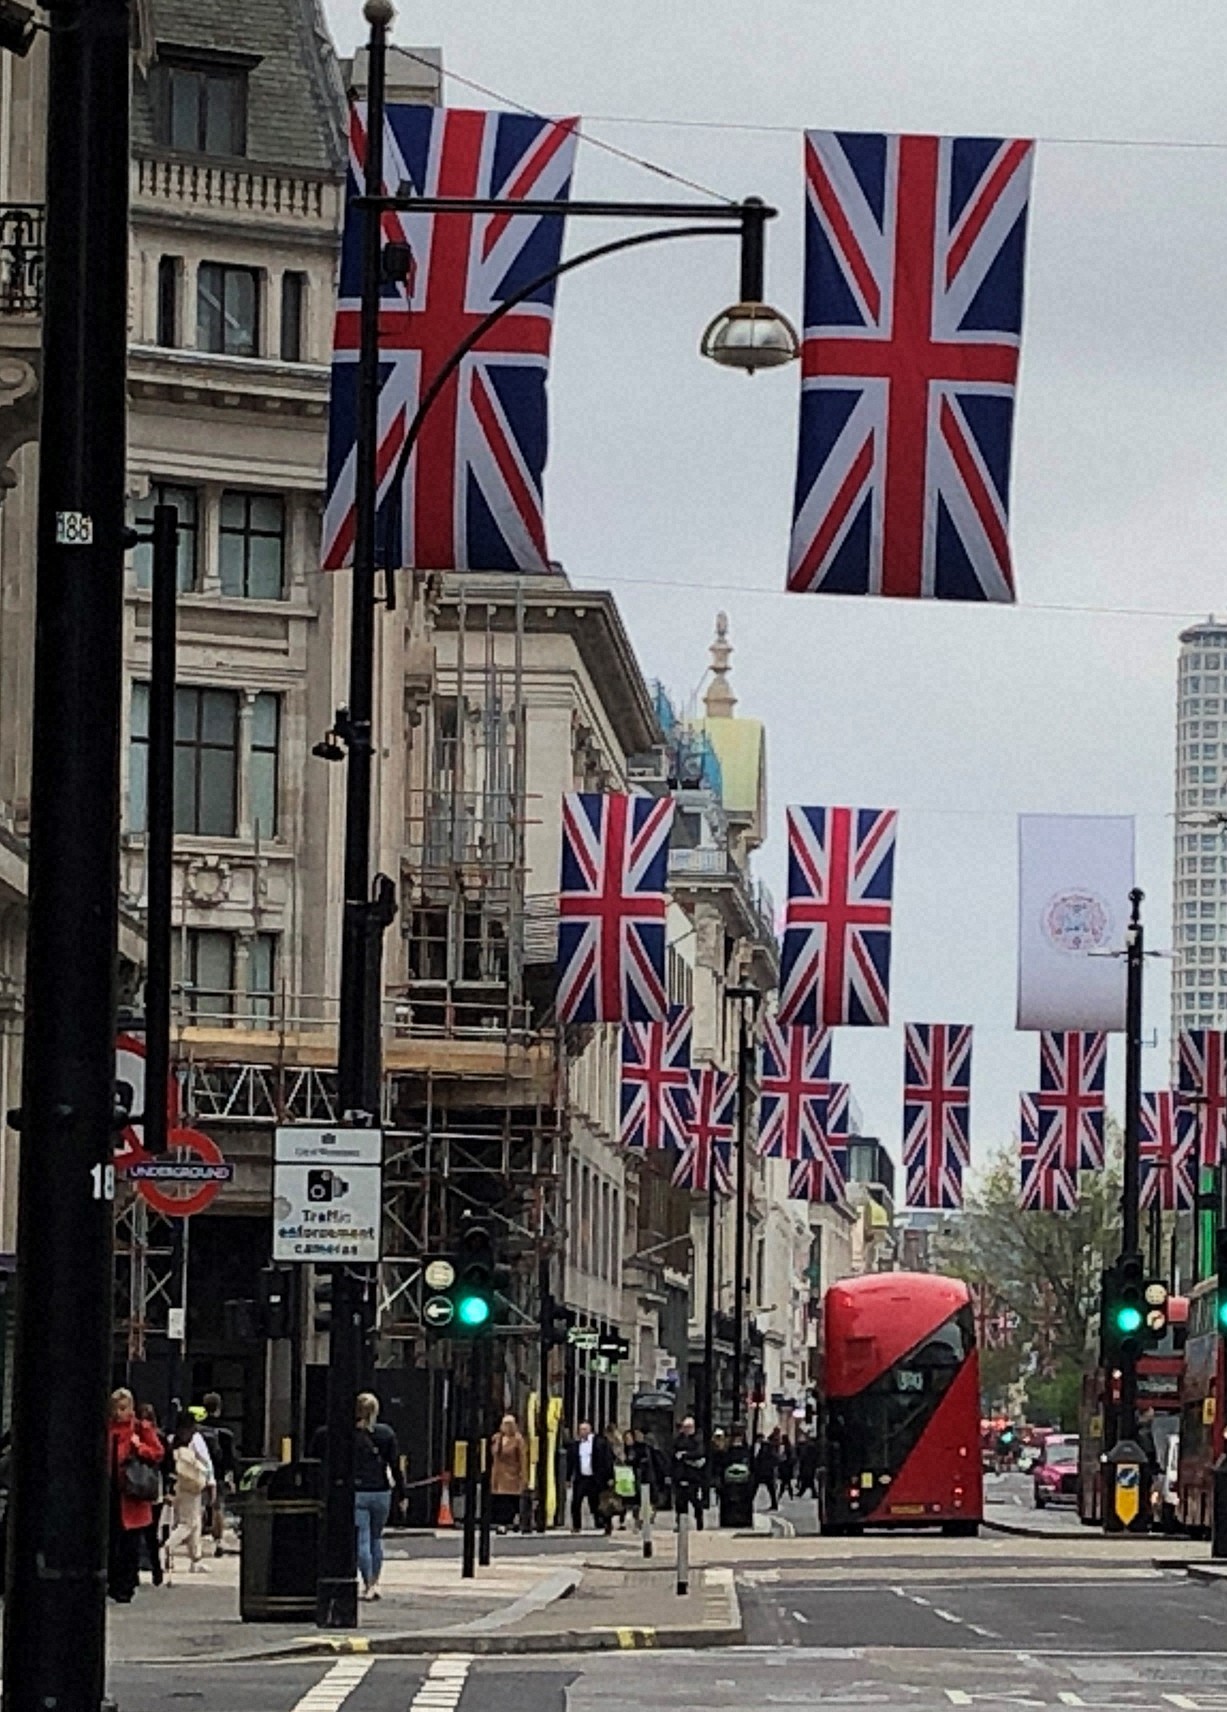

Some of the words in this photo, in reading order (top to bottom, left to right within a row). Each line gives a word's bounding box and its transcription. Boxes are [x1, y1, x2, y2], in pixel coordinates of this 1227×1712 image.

[130, 1166, 230, 1179] UNDERGROUND
[302, 1209, 351, 1223] Traffic
[278, 1225, 375, 1240] enforcement
[295, 1244, 358, 1256] cameras
